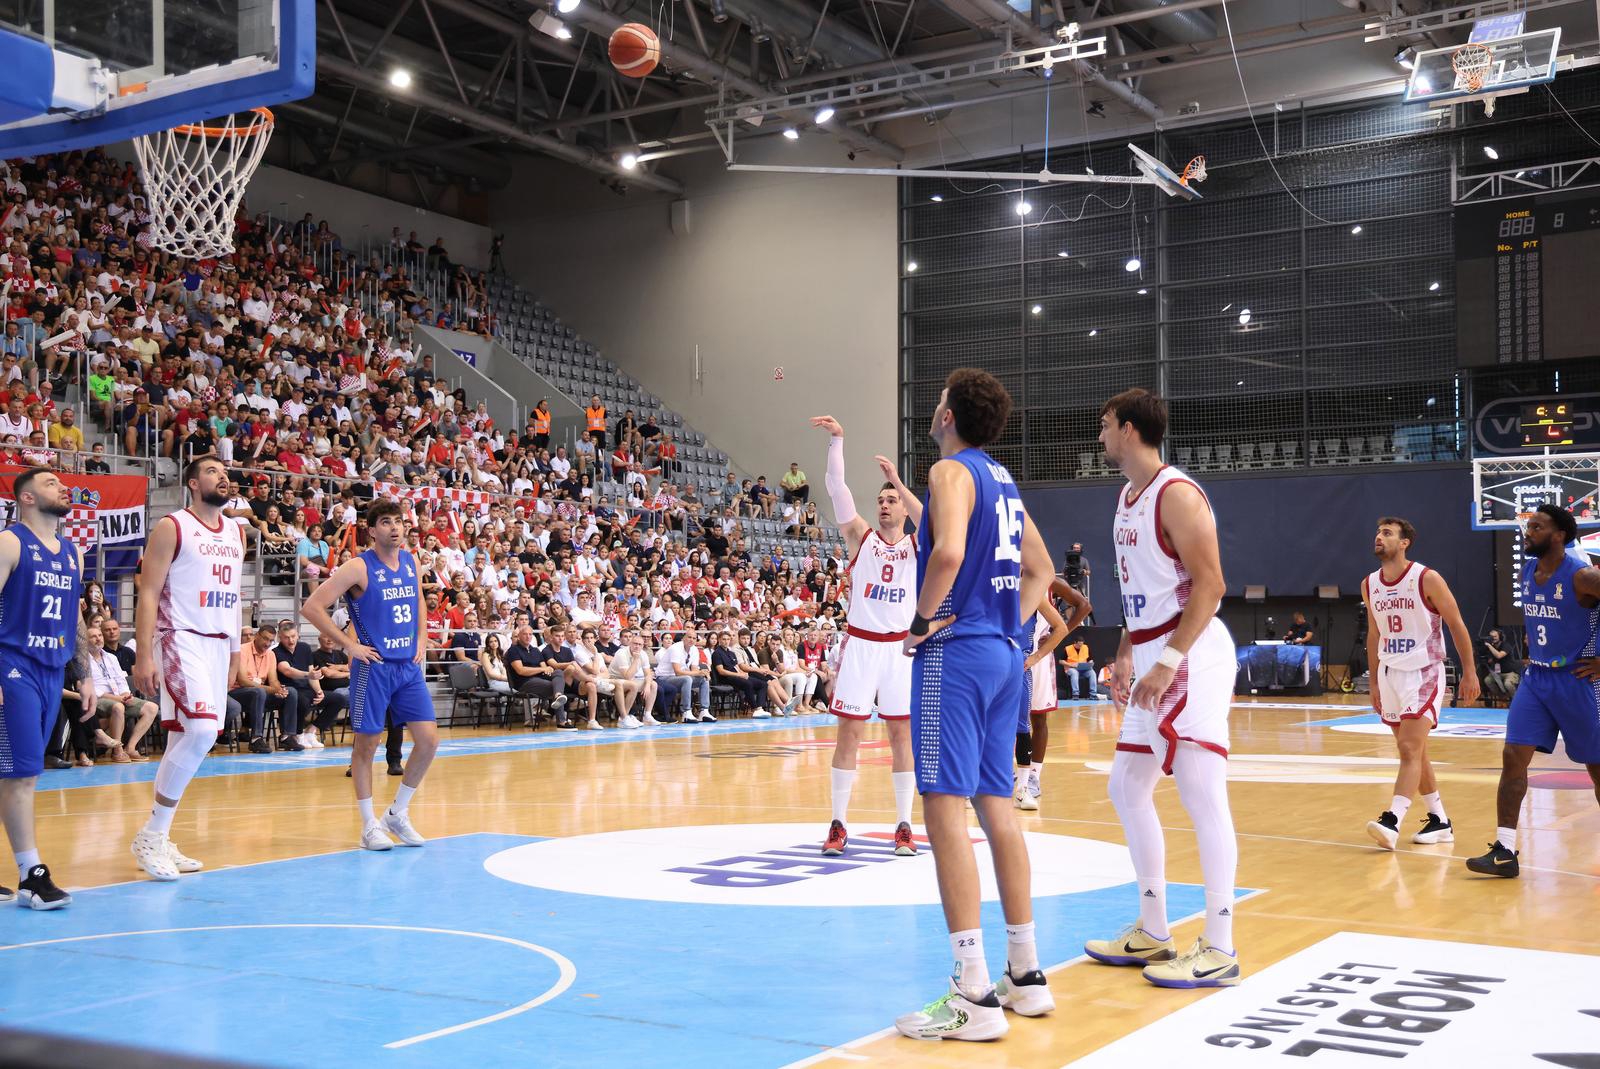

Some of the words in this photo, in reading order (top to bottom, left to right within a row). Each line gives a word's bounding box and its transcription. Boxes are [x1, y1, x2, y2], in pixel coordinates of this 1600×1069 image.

[1506, 211, 1530, 219] HOME
[1523, 240, 1538, 249] P/T
[994, 494, 1024, 563] 15
[199, 543, 240, 560] CROATIA
[34, 571, 73, 590] ISRAEL
[212, 563, 232, 585] 40
[881, 564, 894, 583] 8
[215, 591, 237, 608] HEP
[382, 586, 416, 600] ISRAEL
[877, 585, 906, 603] HEP
[41, 595, 62, 620] 21
[393, 604, 412, 623] 33
[1374, 598, 1415, 612] CROATIA
[1524, 604, 1561, 619] ISRAEL
[1387, 615, 1403, 633] 18
[1536, 624, 1547, 646] 3
[1386, 639, 1416, 653] HEP
[958, 937, 975, 947] 23
[1204, 962, 1398, 1050] LEASING
[1281, 969, 1507, 1059] MOBIL
